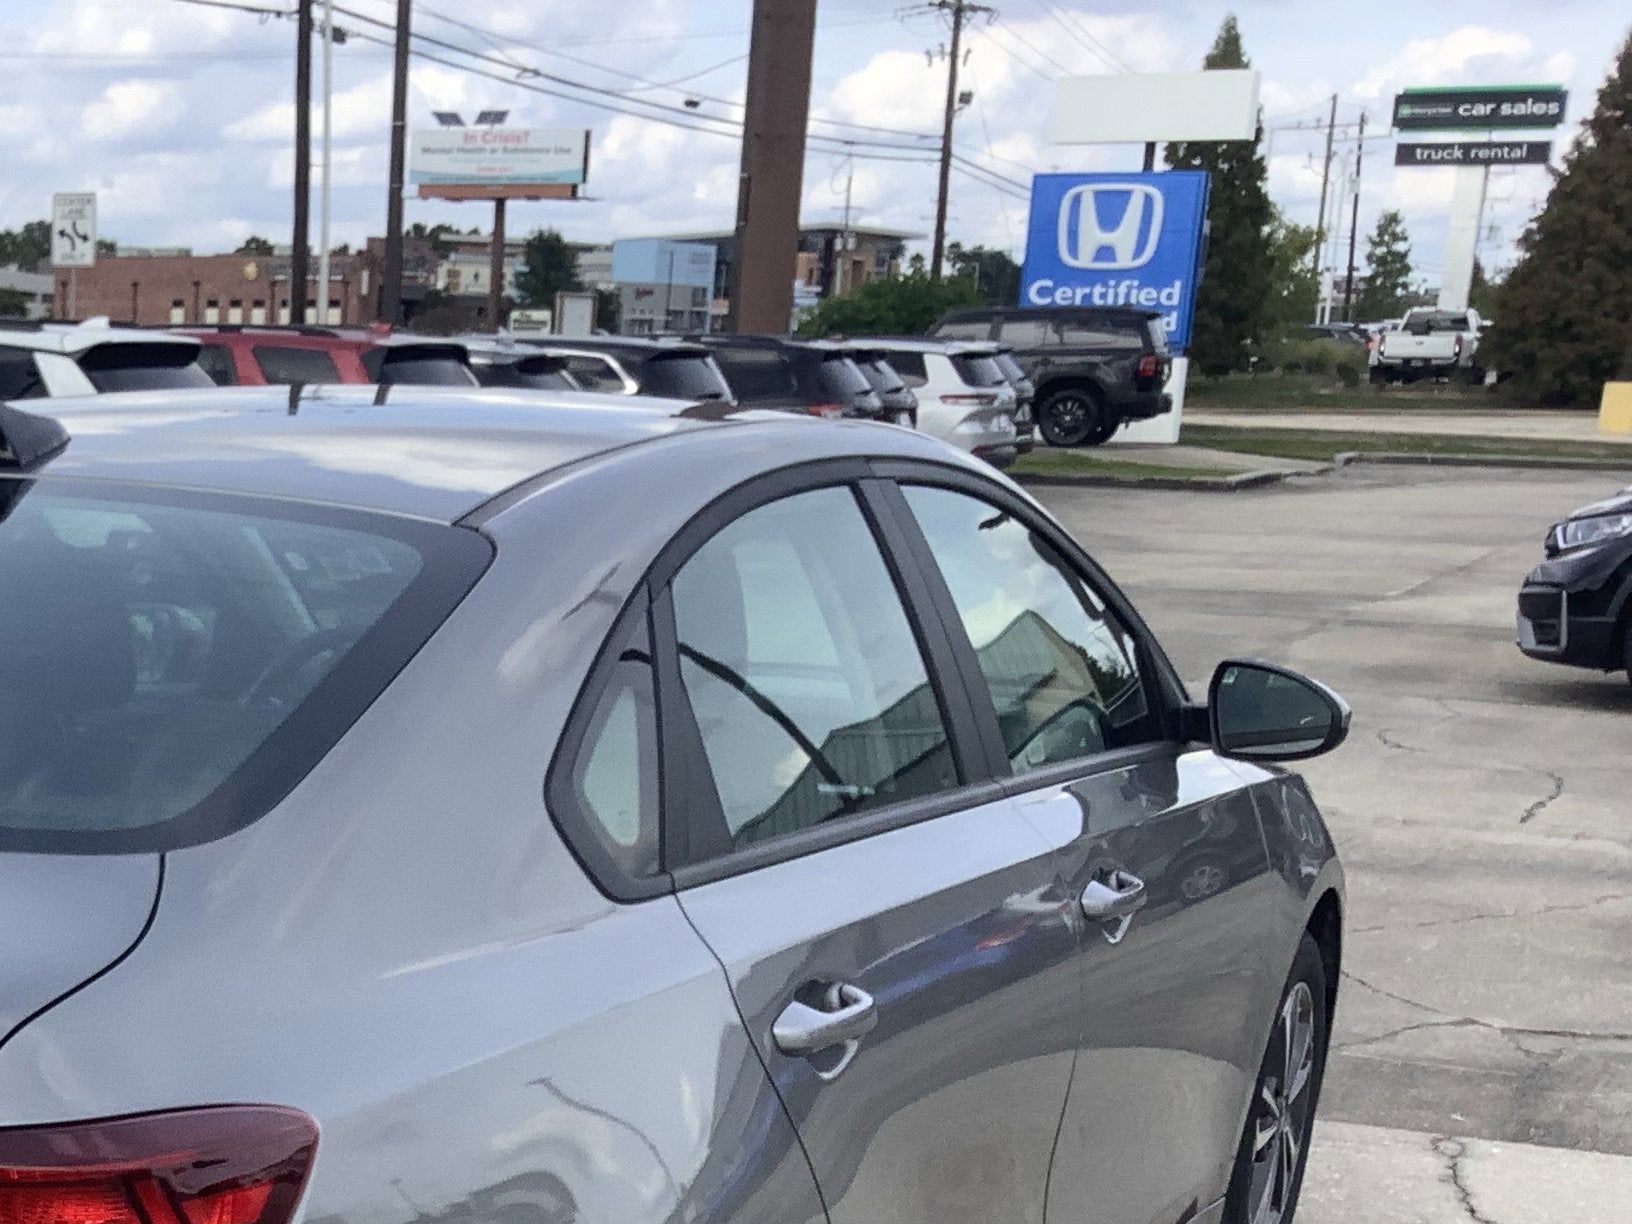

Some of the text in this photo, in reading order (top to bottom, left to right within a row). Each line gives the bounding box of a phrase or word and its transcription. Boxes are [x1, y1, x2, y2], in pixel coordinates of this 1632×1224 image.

[1458, 103, 1497, 117] car
[1500, 97, 1560, 116] sales
[463, 131, 475, 144] In
[1415, 144, 1528, 160] truck rental
[1028, 278, 1182, 306] Certified
